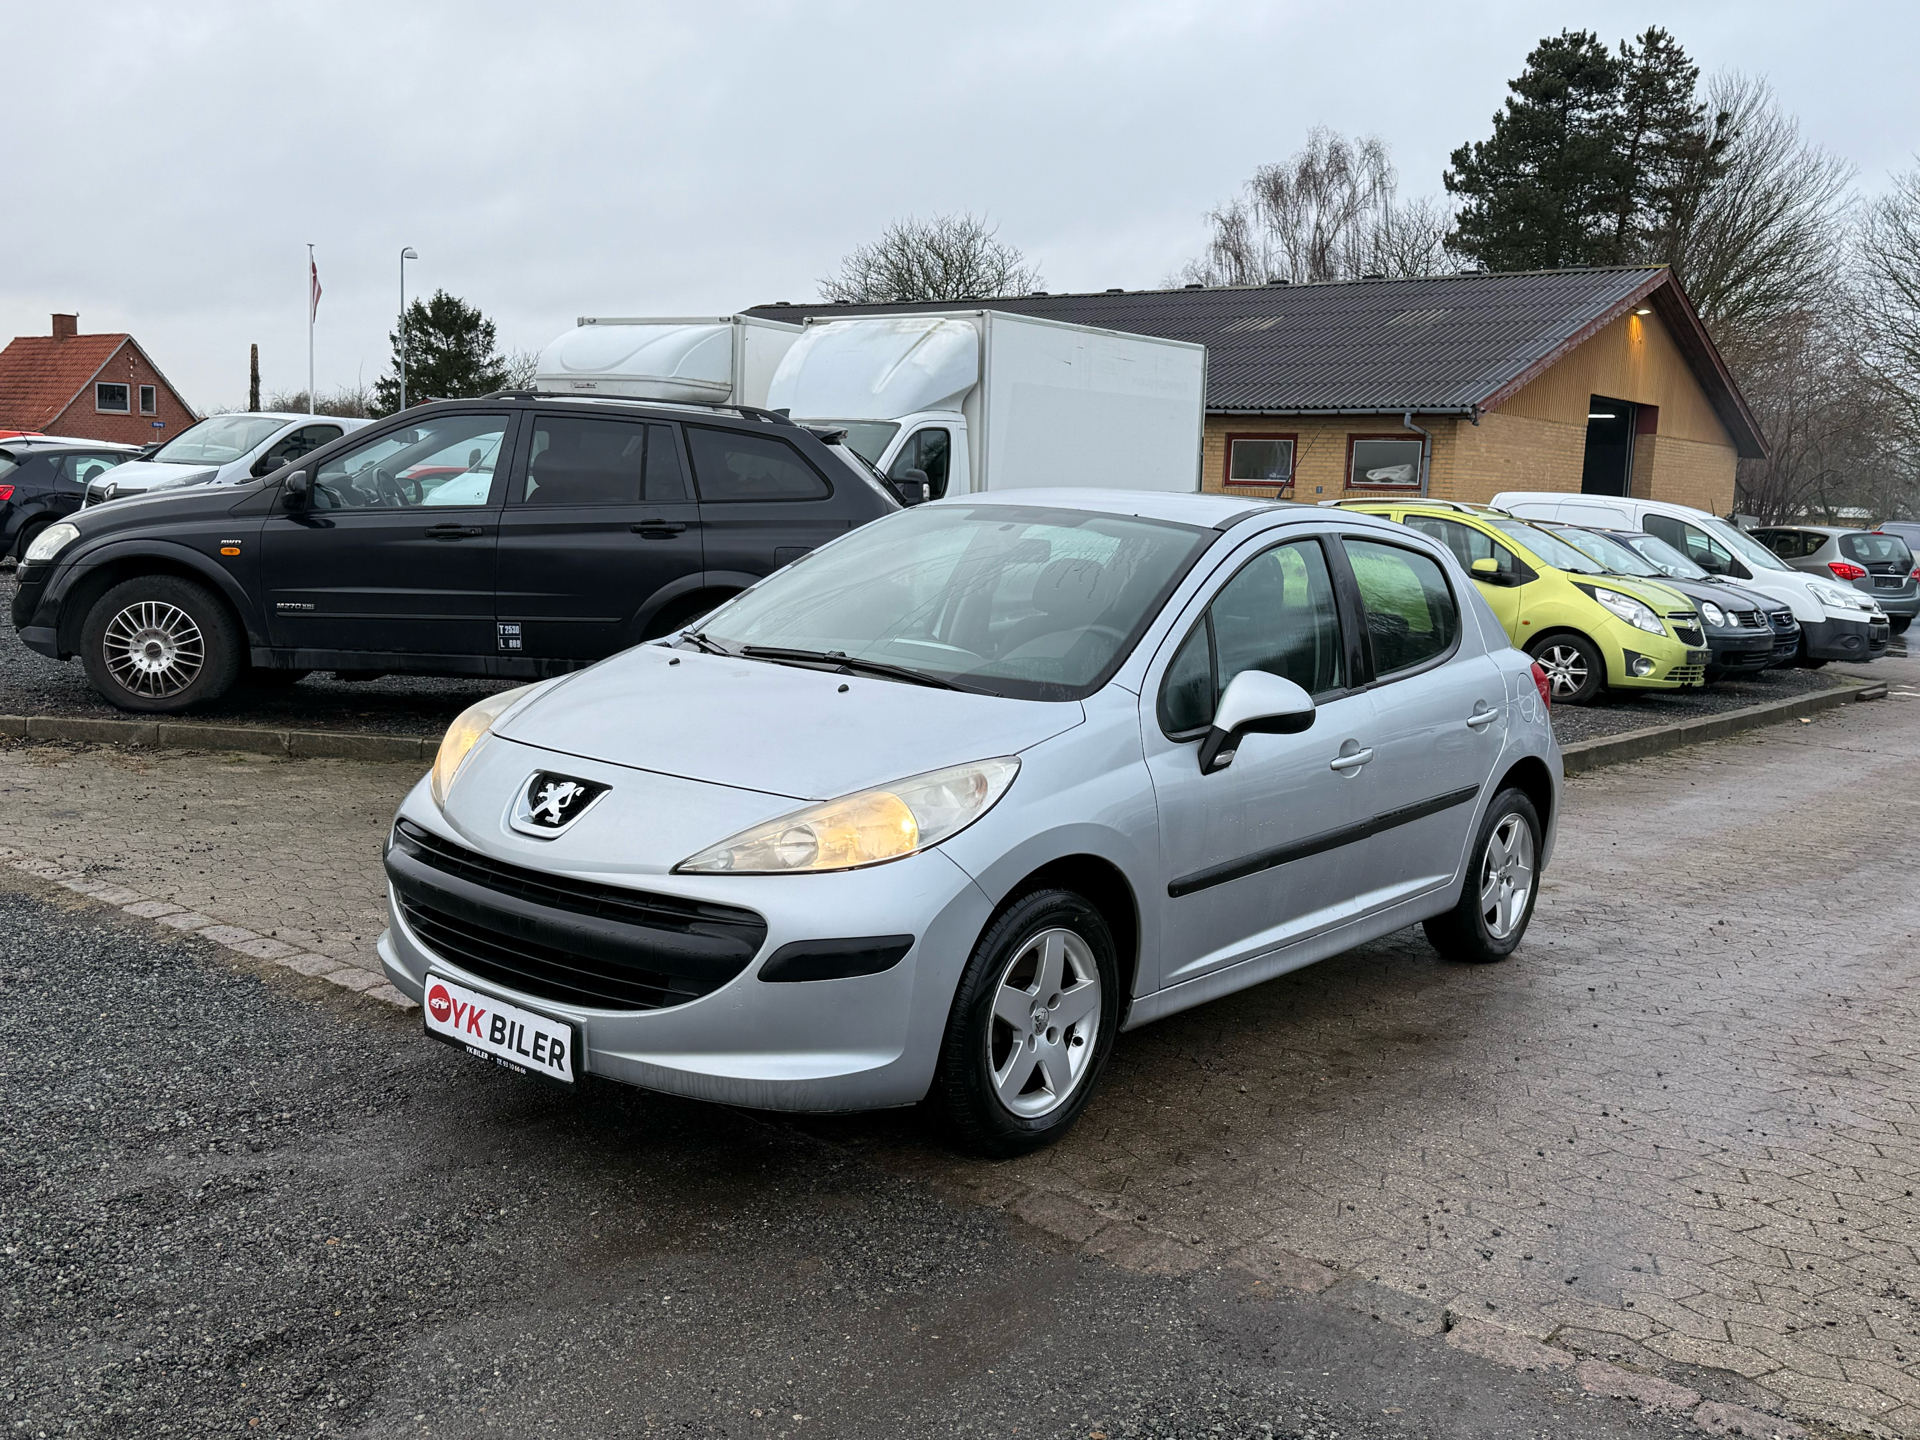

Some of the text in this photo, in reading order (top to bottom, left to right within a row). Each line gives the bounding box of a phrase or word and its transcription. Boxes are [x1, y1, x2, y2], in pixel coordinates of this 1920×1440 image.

[499, 625, 520, 634] T 2530
[500, 638, 505, 648] L
[451, 997, 565, 1072] YK BILER
[473, 1048, 489, 1060] BILER
